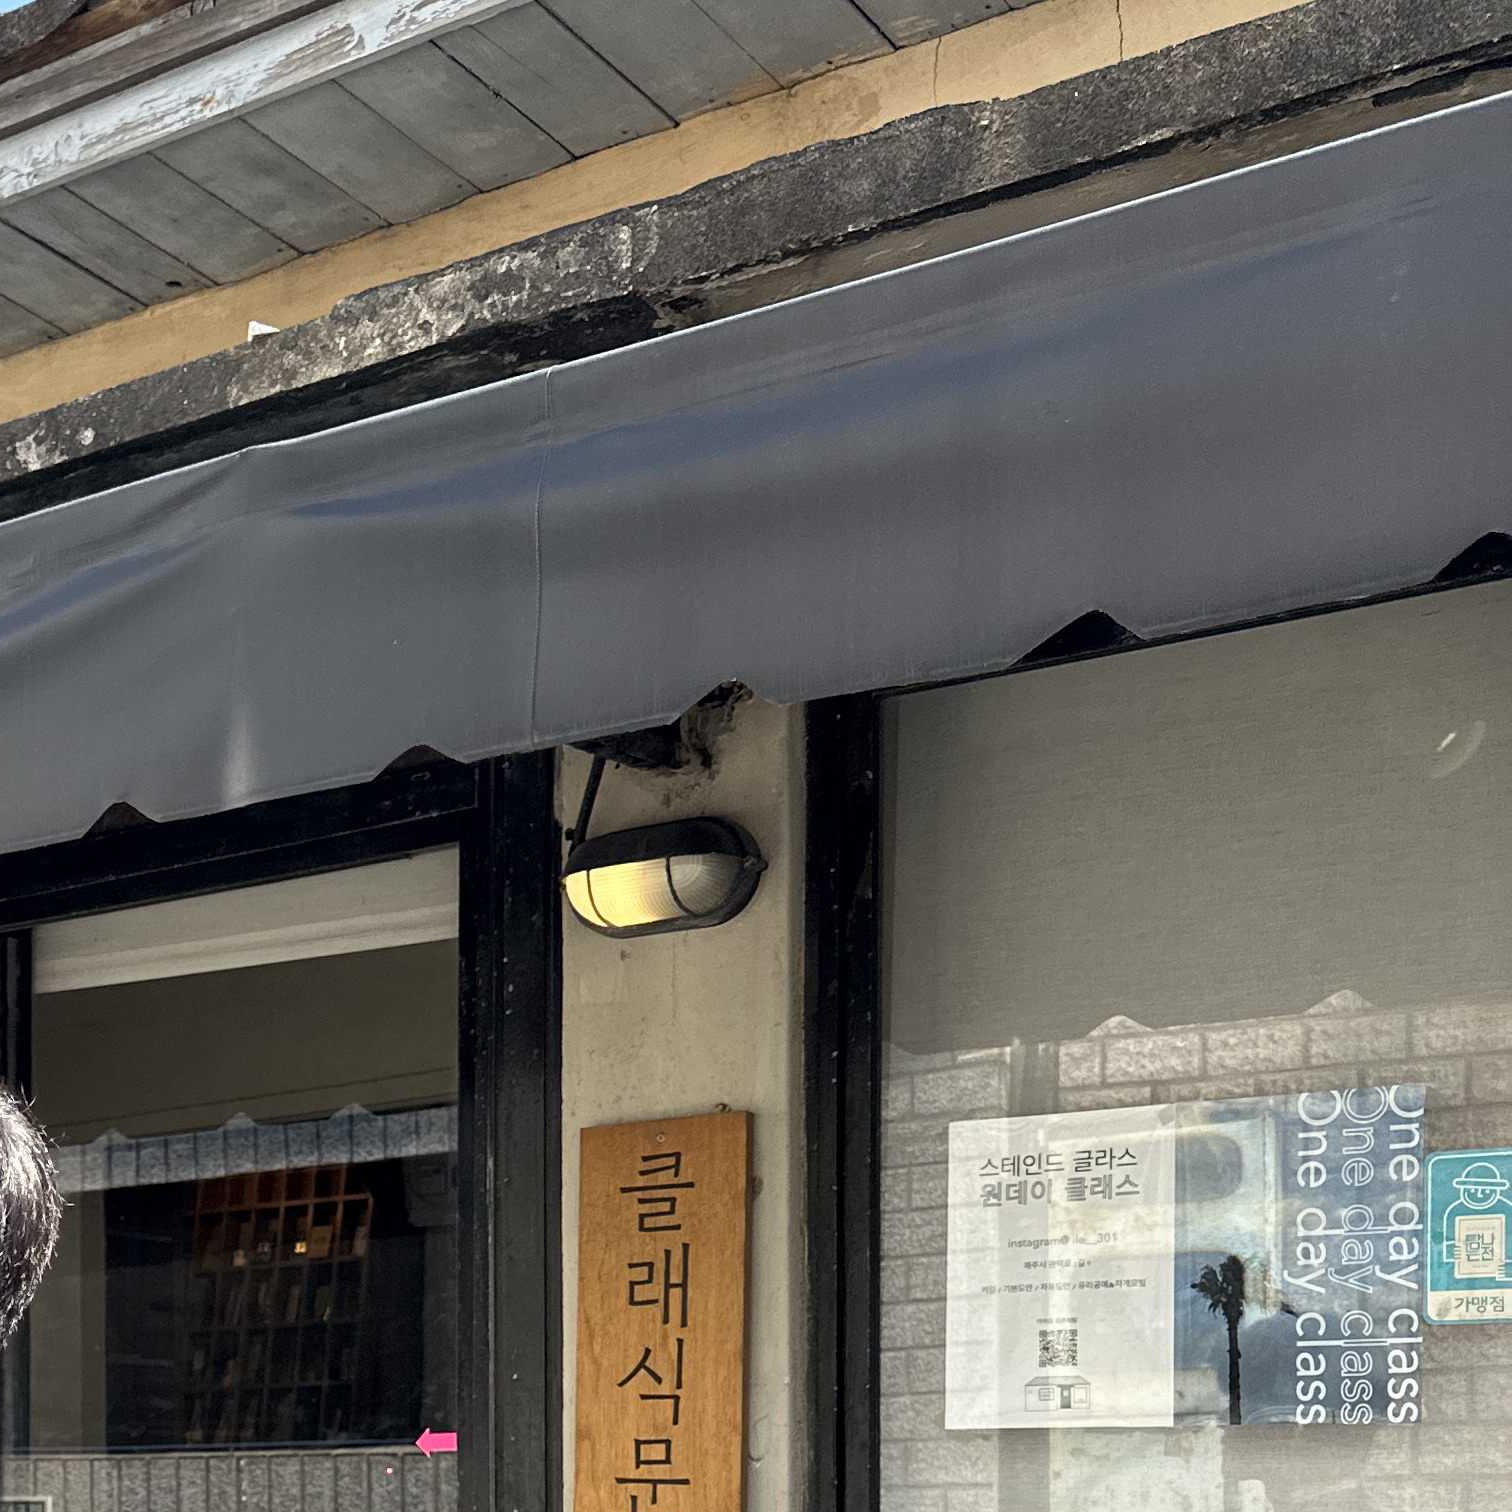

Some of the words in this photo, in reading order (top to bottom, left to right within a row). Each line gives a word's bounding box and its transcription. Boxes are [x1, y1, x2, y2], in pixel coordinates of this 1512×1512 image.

[979, 1151, 1065, 1177] 스테인드
[1073, 1147, 1139, 1173] 글라스
[1296, 1089, 1342, 1189] One
[1341, 1085, 1389, 1187] One
[1388, 1085, 1424, 1182] One
[980, 1178, 1053, 1207] 원데이
[1064, 1173, 1141, 1201] 클래스
[1283, 1206, 1344, 1294] day
[1328, 1204, 1390, 1294] day
[1375, 1201, 1424, 1290] day
[1454, 1295, 1505, 1313] 가맹점
[1295, 1311, 1342, 1425] class
[1340, 1310, 1389, 1425] class
[1387, 1308, 1424, 1424] class
